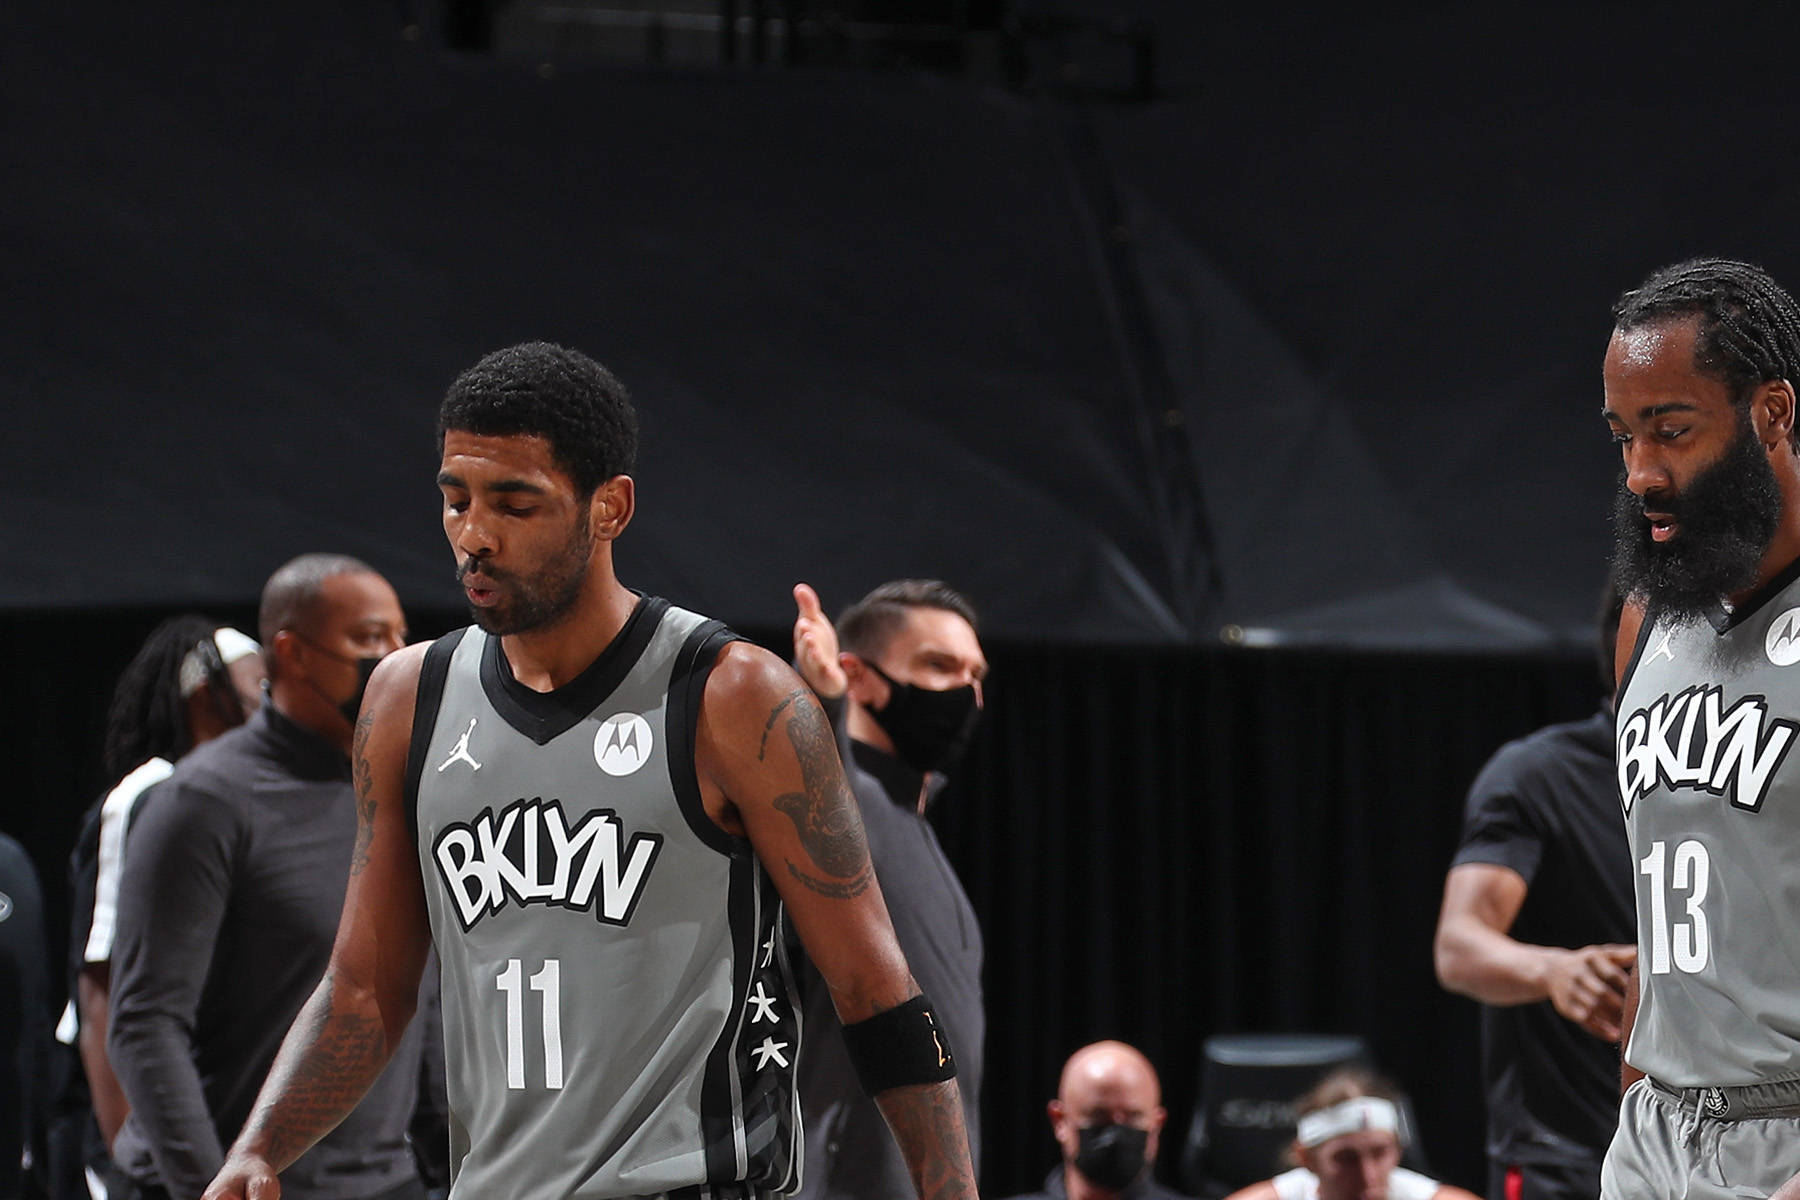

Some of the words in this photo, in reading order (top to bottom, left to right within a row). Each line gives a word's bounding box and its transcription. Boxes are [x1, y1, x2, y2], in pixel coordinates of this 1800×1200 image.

[1616, 685, 1800, 818] BKLYN
[433, 798, 664, 932] BKLYN
[1640, 840, 1710, 975] 13
[496, 958, 563, 1089] 11
